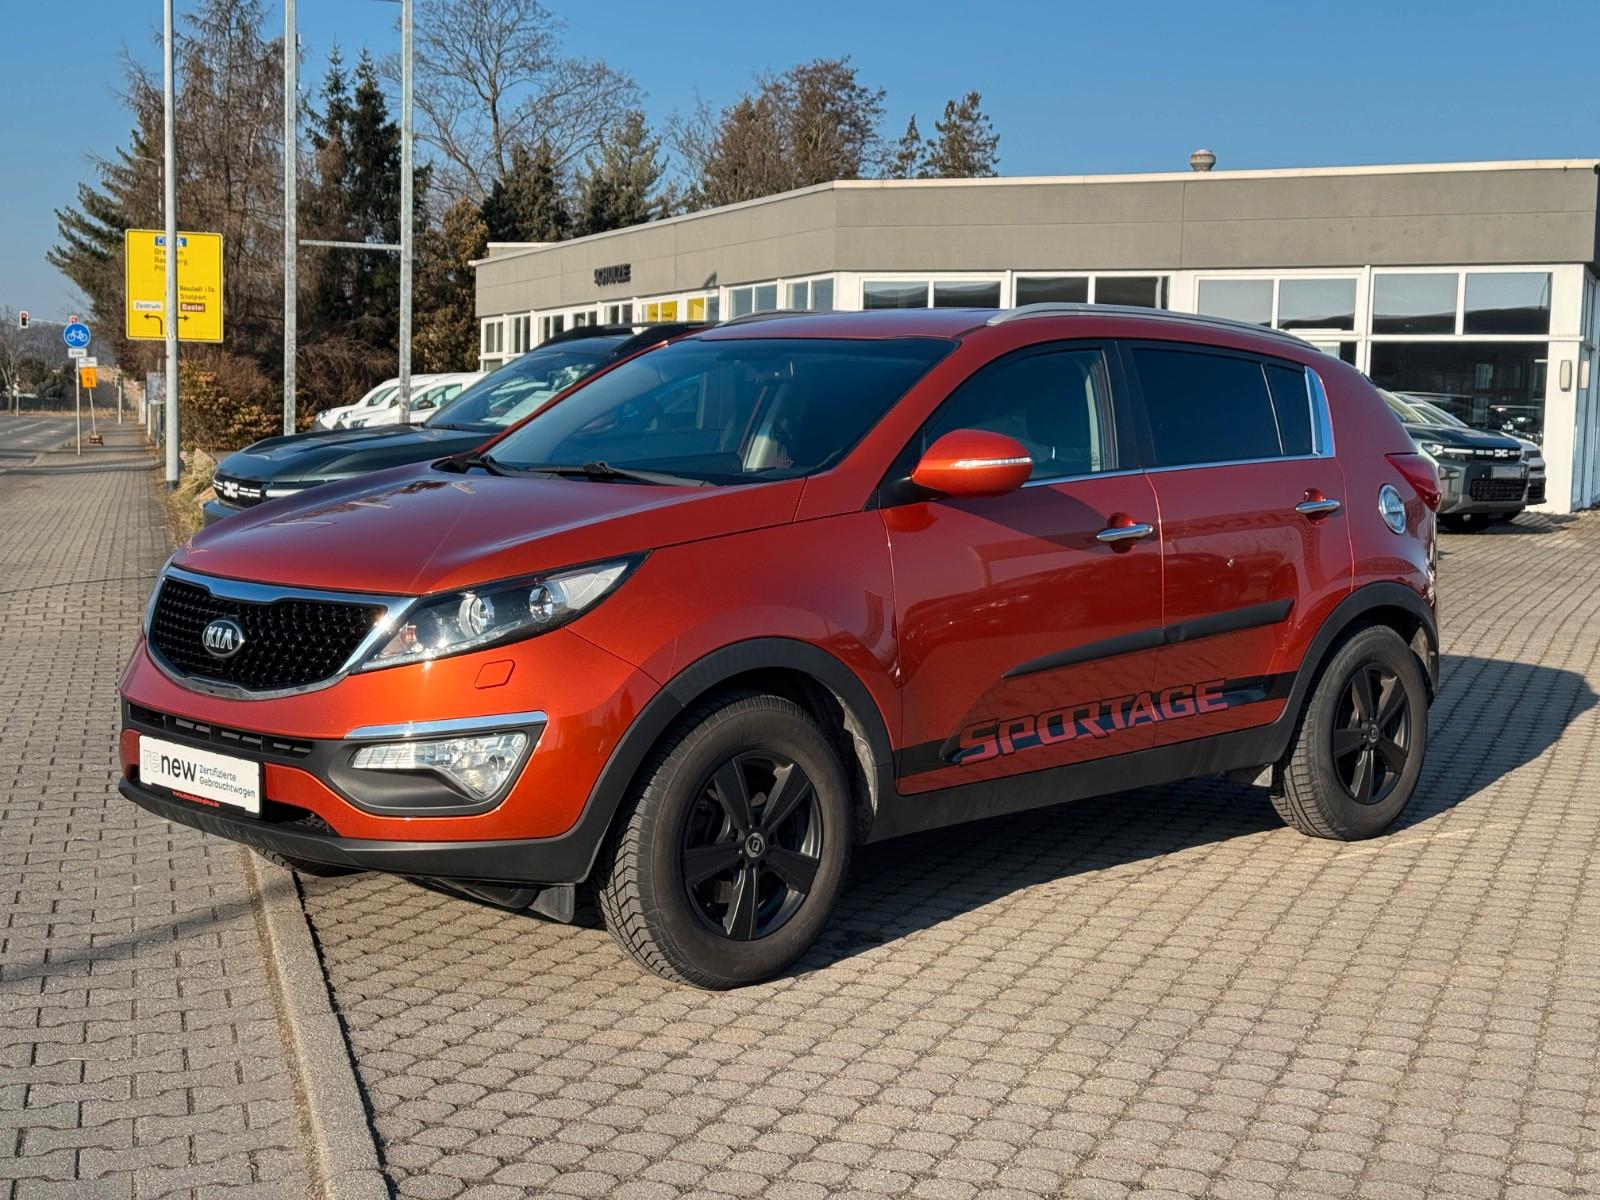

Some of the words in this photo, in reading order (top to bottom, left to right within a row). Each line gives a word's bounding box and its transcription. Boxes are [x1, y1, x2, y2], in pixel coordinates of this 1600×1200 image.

[205, 626, 233, 650] KIA
[959, 679, 1229, 766] SPORTAGE
[199, 764, 237, 782] Zertifizierte
[199, 776, 256, 798] Gebrauchtwagen
